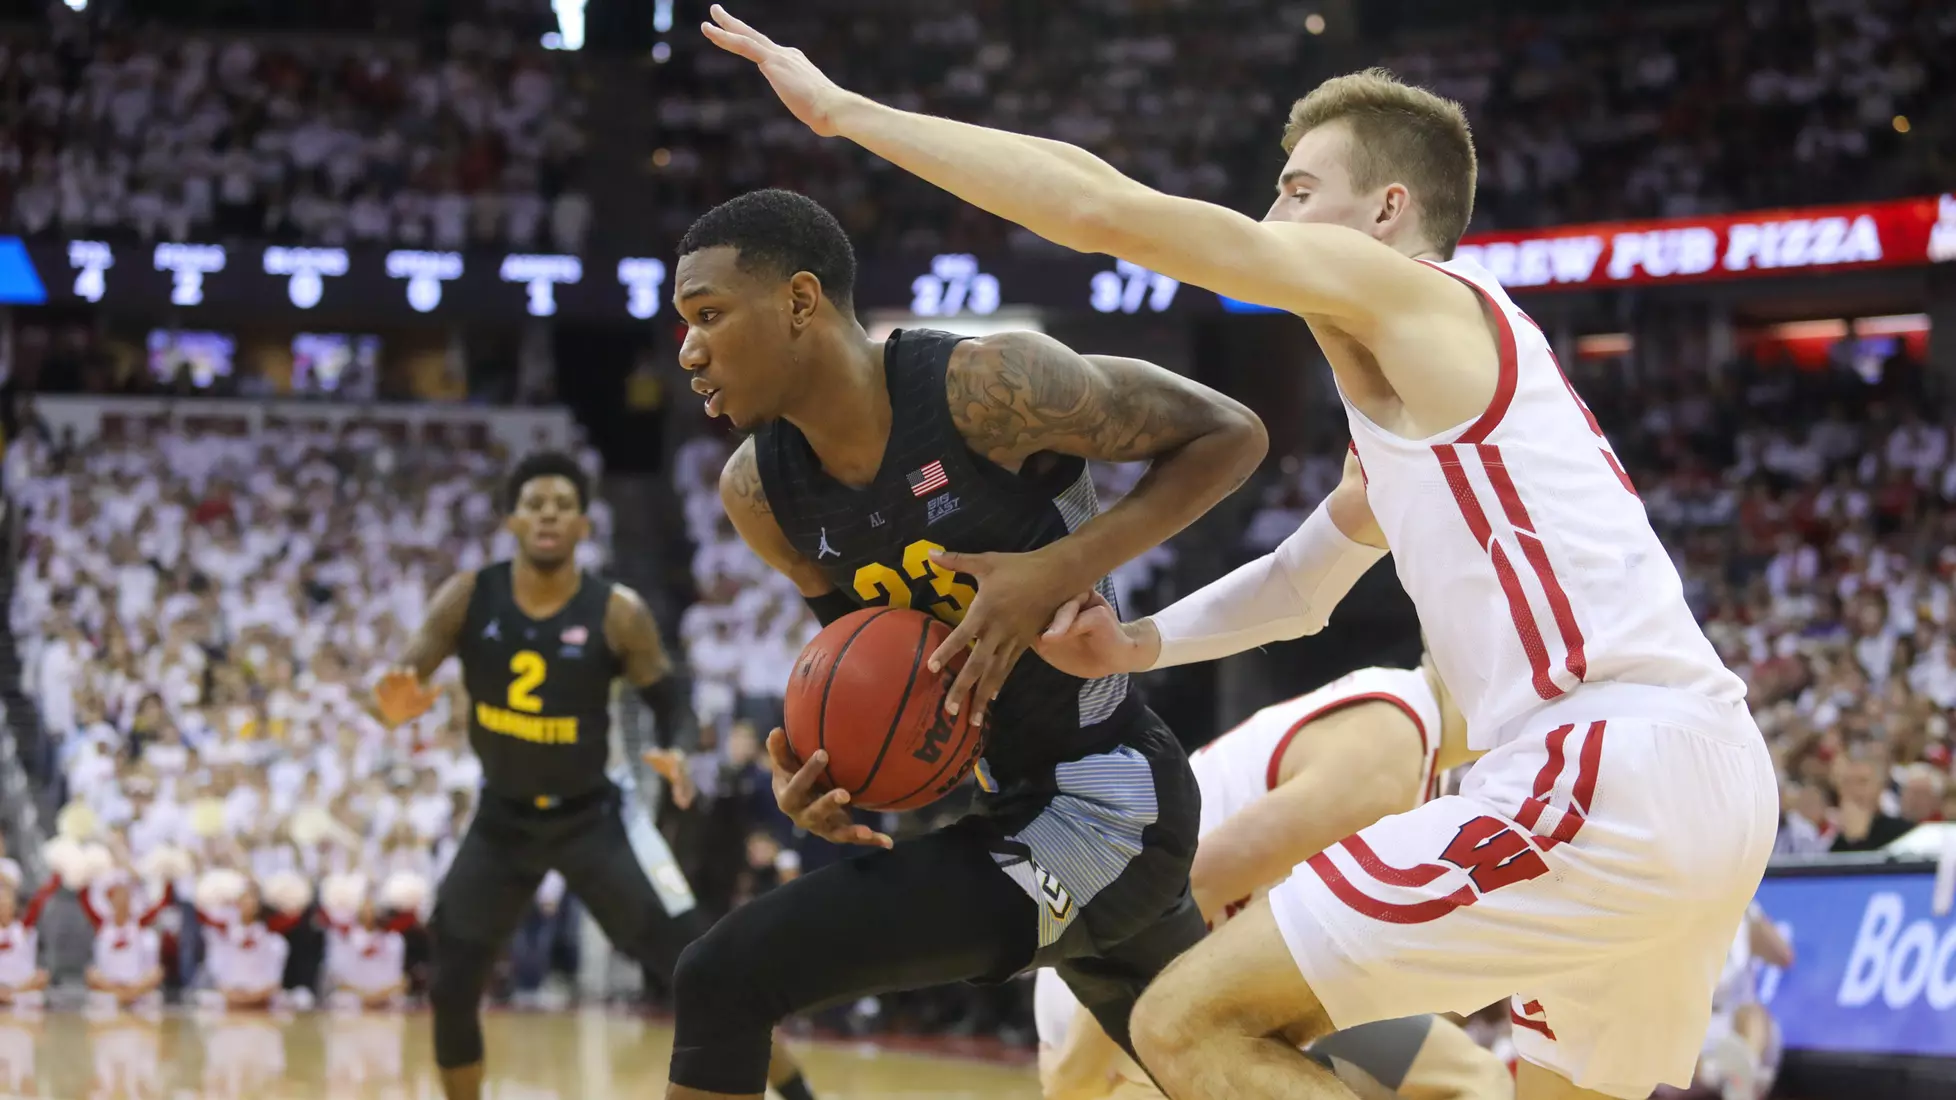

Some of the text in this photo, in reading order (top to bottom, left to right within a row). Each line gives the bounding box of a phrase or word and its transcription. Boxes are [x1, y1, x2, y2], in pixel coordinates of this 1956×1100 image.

[1608, 227, 1717, 279] PUB
[1724, 215, 1881, 271] PIZZA
[869, 511, 886, 528] AL
[927, 492, 950, 510] BIG
[927, 497, 960, 520] EAST
[507, 650, 547, 713] 2
[1438, 815, 1550, 894] W
